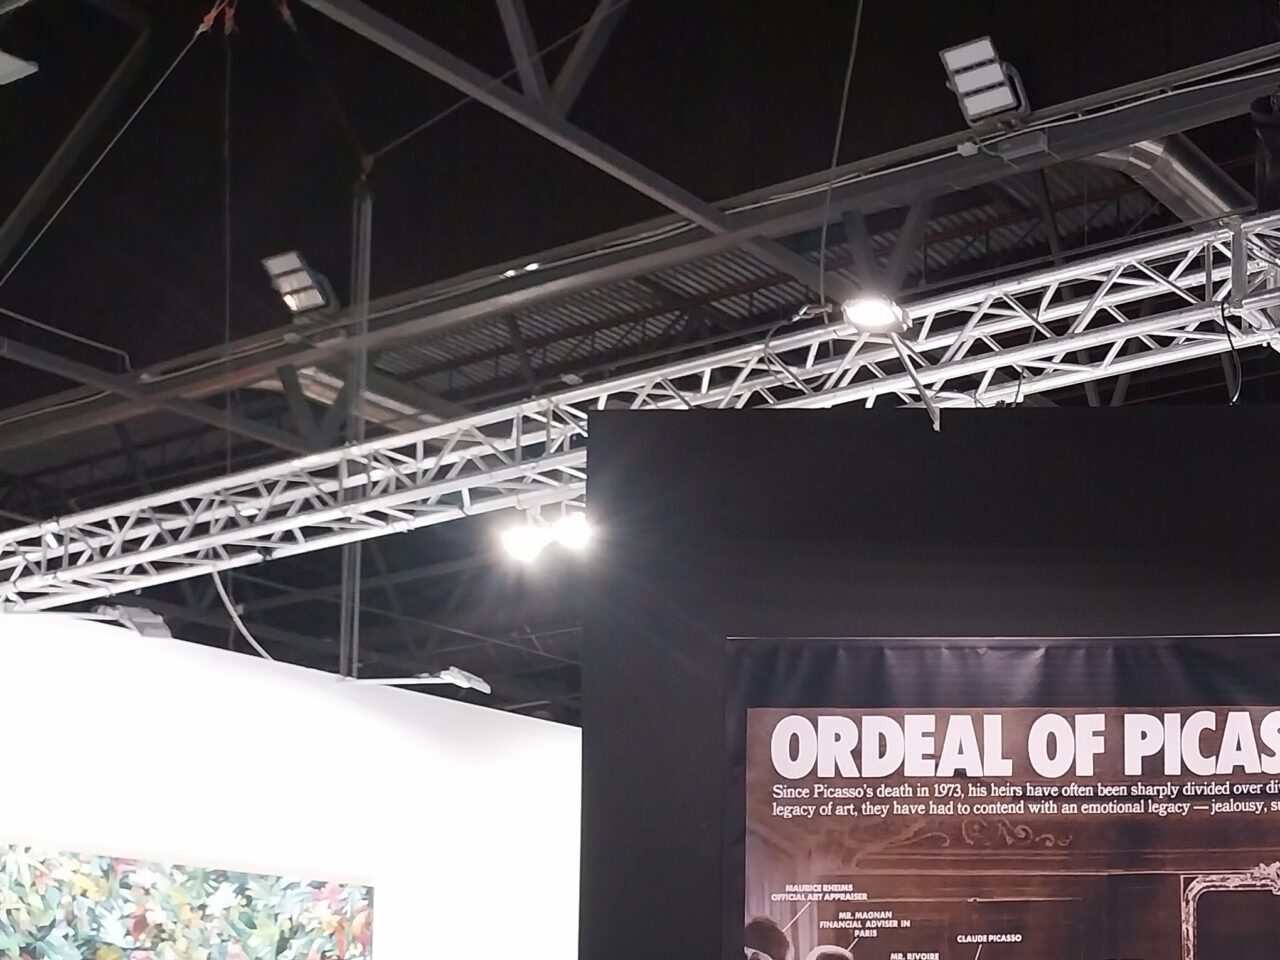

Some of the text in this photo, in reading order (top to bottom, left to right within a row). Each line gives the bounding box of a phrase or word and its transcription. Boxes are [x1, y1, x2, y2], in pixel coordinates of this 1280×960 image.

[771, 714, 1012, 779] ORDEAL
[1028, 713, 1105, 778] OF
[773, 784, 809, 798] Since
[814, 784, 873, 798] Picasso's
[877, 784, 912, 797] death
[917, 784, 929, 797] in
[934, 784, 964, 799] 1973,
[968, 783, 987, 797] his
[991, 783, 1022, 797] heirs
[1026, 784, 1058, 797] have
[1062, 783, 1093, 796] often
[1098, 783, 1127, 796] been
[1131, 782, 1179, 798] sharply
[1183, 781, 1230, 795] divided
[1234, 784, 1263, 795] over
[773, 802, 816, 818] legacy
[820, 802, 833, 815] of
[836, 803, 857, 817] art,
[862, 802, 889, 817] they
[893, 801, 925, 815] have
[929, 801, 953, 815] had
[957, 802, 970, 815] to
[973, 801, 1024, 815] contend
[1028, 801, 1057, 814] with
[1062, 802, 1077, 813] an
[1081, 800, 1144, 813] emotional
[1148, 800, 1190, 816] legacy
[1211, 799, 1267, 815] jealousy,
[823, 884, 853, 892] RHEIMS
[865, 920, 898, 928] ADVISER
